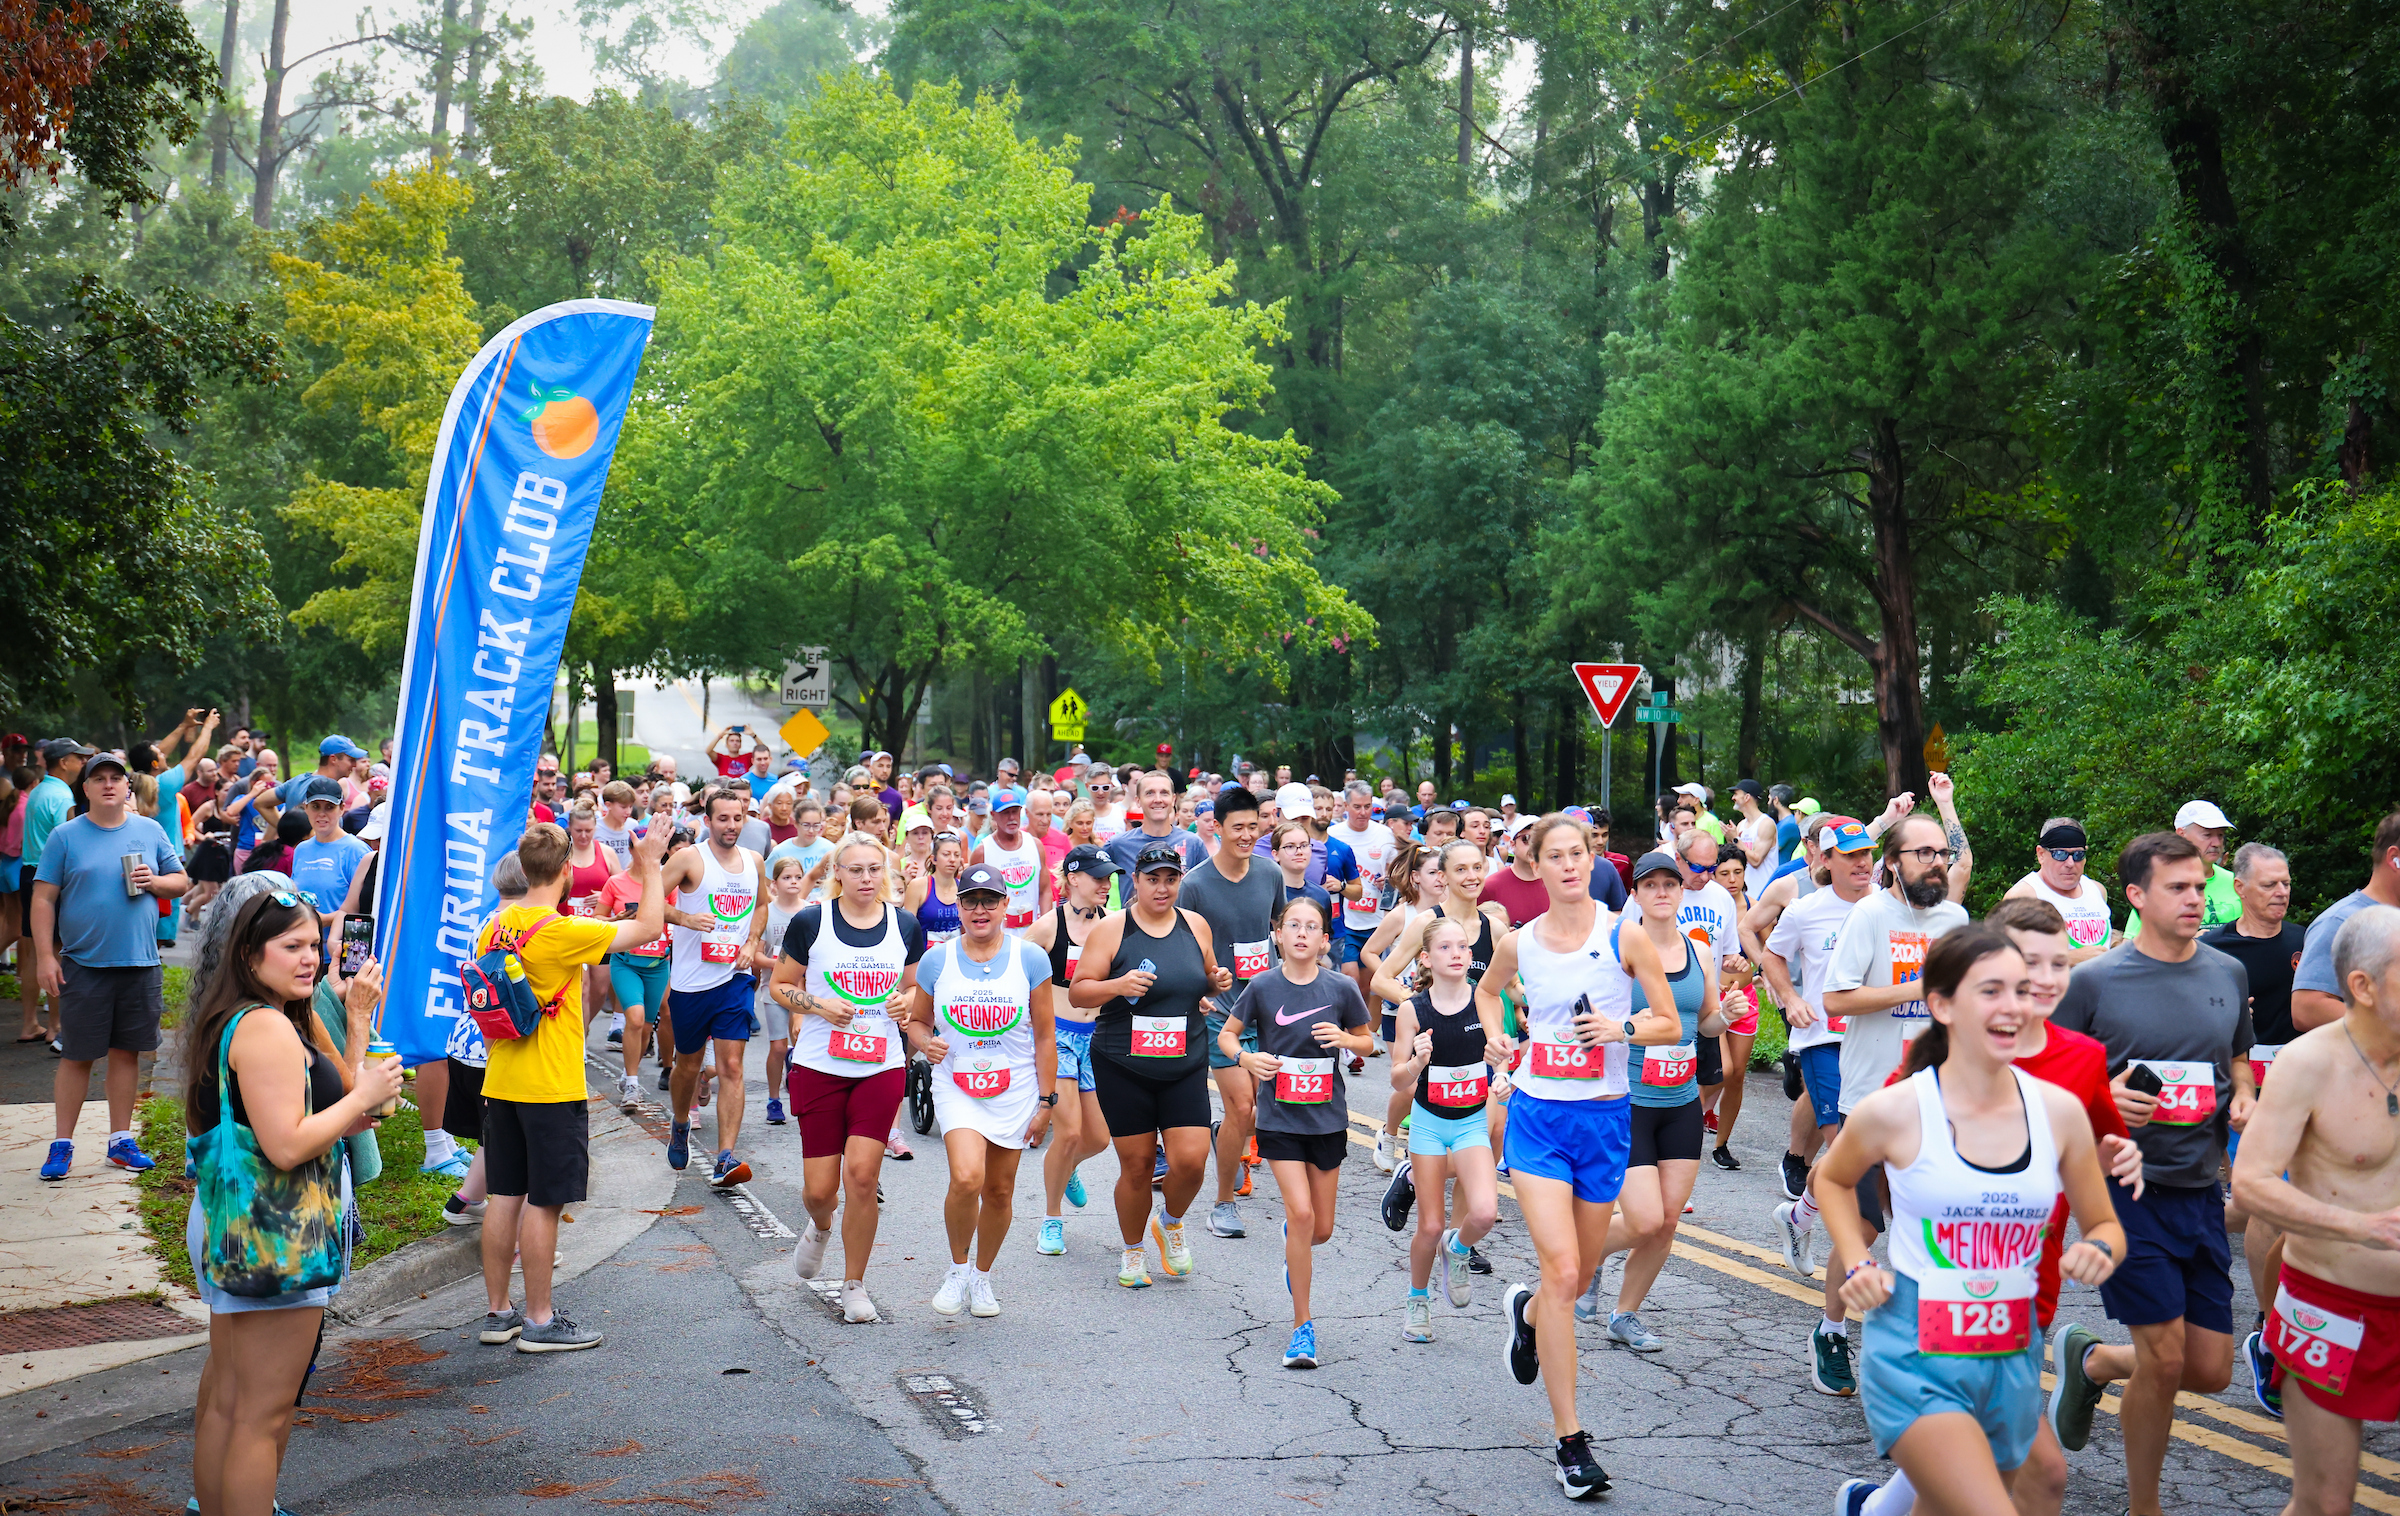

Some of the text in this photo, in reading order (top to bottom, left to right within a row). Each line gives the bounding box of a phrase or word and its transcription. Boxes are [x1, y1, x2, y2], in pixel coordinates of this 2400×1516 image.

[786, 689, 826, 700] RIGHT
[1637, 709, 1650, 720] NW
[1056, 730, 1080, 738] AHEAD
[425, 470, 567, 1018] FLORIDA TRACK CLUB
[573, 907, 594, 916] 150
[938, 908, 958, 918] RUN
[1018, 914, 1022, 923] 1
[1676, 906, 1722, 929] LORIDA
[709, 944, 736, 957] 232
[1890, 942, 1923, 963] 2024
[1240, 954, 1268, 970] 200
[833, 971, 898, 997] MELONRUN
[950, 1004, 1016, 1030] MELONRUN
[843, 1034, 875, 1053] 163
[1142, 1032, 1178, 1048] 286
[1544, 1046, 1587, 1067] 136
[1658, 1062, 1689, 1078] 159
[966, 1072, 999, 1090] 162
[1289, 1075, 1322, 1093] 132
[1441, 1080, 1478, 1099] 144
[2160, 1086, 2198, 1110] 34
[1982, 1192, 2019, 1204] 2025
[1941, 1206, 2049, 1219] JACK GAMBLE
[1948, 1303, 2011, 1336] 128
[2278, 1320, 2329, 1368] 178
